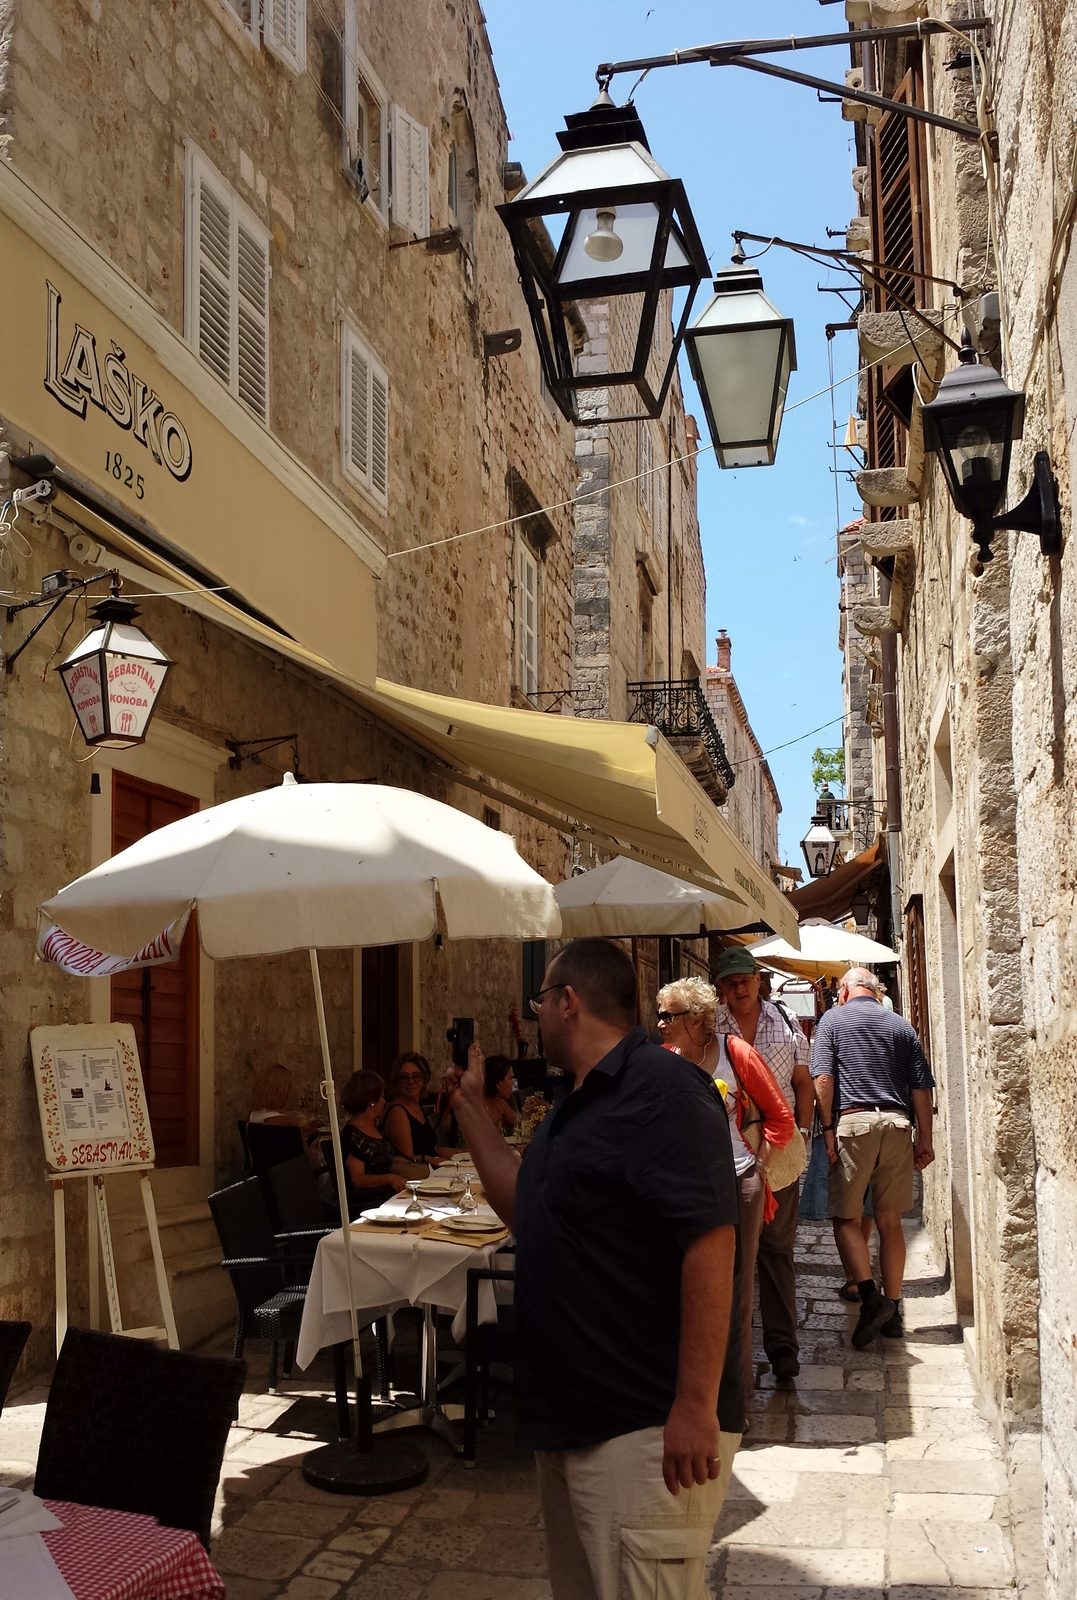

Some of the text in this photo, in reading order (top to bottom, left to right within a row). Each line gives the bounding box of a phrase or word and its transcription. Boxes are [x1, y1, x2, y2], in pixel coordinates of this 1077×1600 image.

[44, 278, 193, 483] LAŠKO
[104, 450, 146, 501] 1825
[77, 695, 101, 711] KONOBA
[110, 694, 148, 707] KONOBA
[71, 1141, 133, 1165] SEBASTIAN
